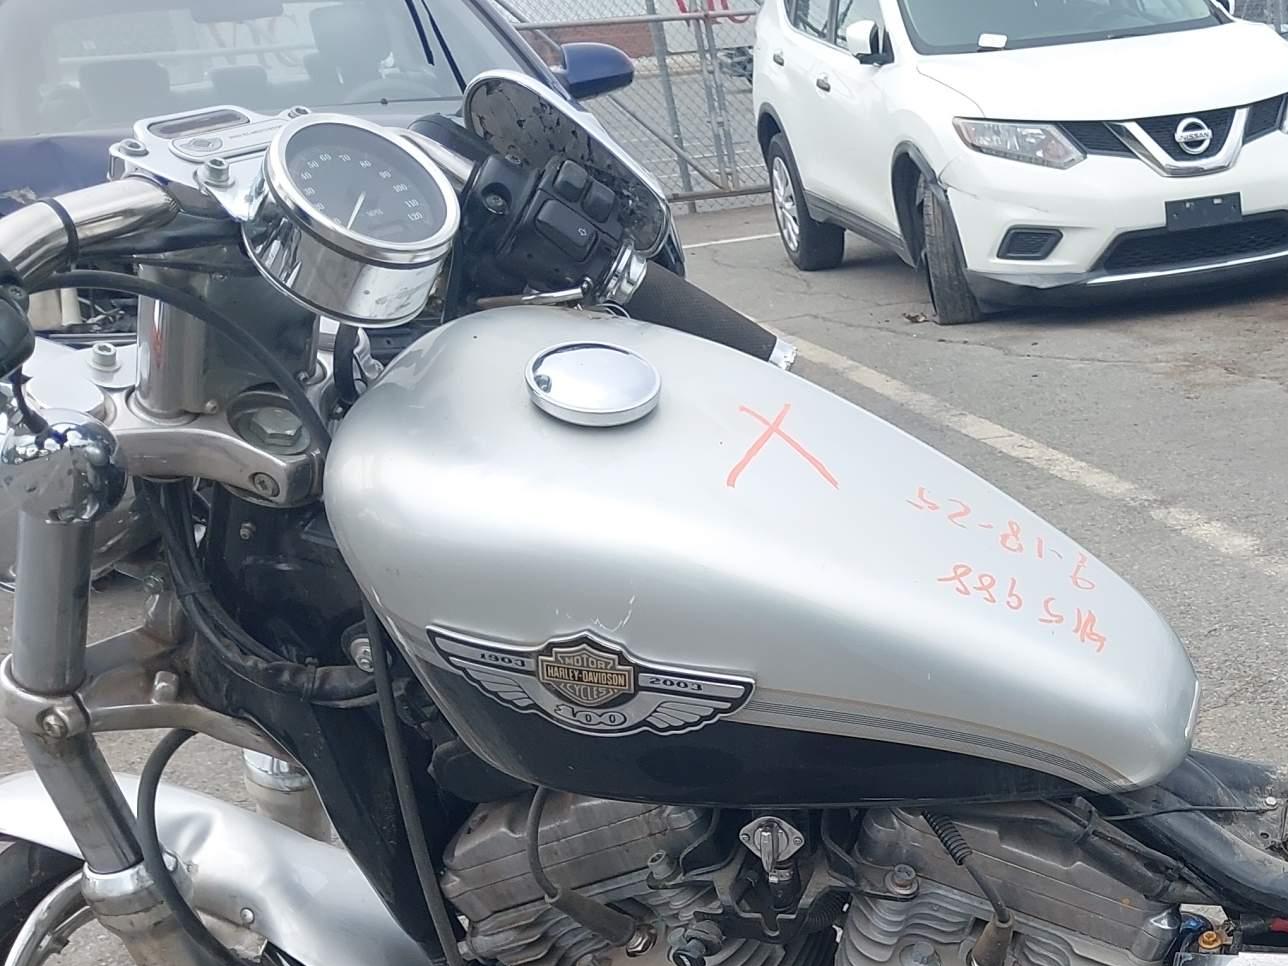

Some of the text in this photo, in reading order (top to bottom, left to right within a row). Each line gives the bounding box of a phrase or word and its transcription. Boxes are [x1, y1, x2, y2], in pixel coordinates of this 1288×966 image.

[1178, 132, 1210, 141] NISSAN
[320, 153, 332, 161] 60
[338, 153, 351, 162] 70
[307, 160, 319, 169] 50
[393, 184, 408, 192] 100
[404, 199, 420, 208] 110
[407, 211, 424, 221] 120
[479, 652, 528, 668] 1903
[565, 654, 607, 670] MOTOR
[546, 665, 626, 687] HARLEY-DAVIDSON
[648, 676, 704, 691] 2003
